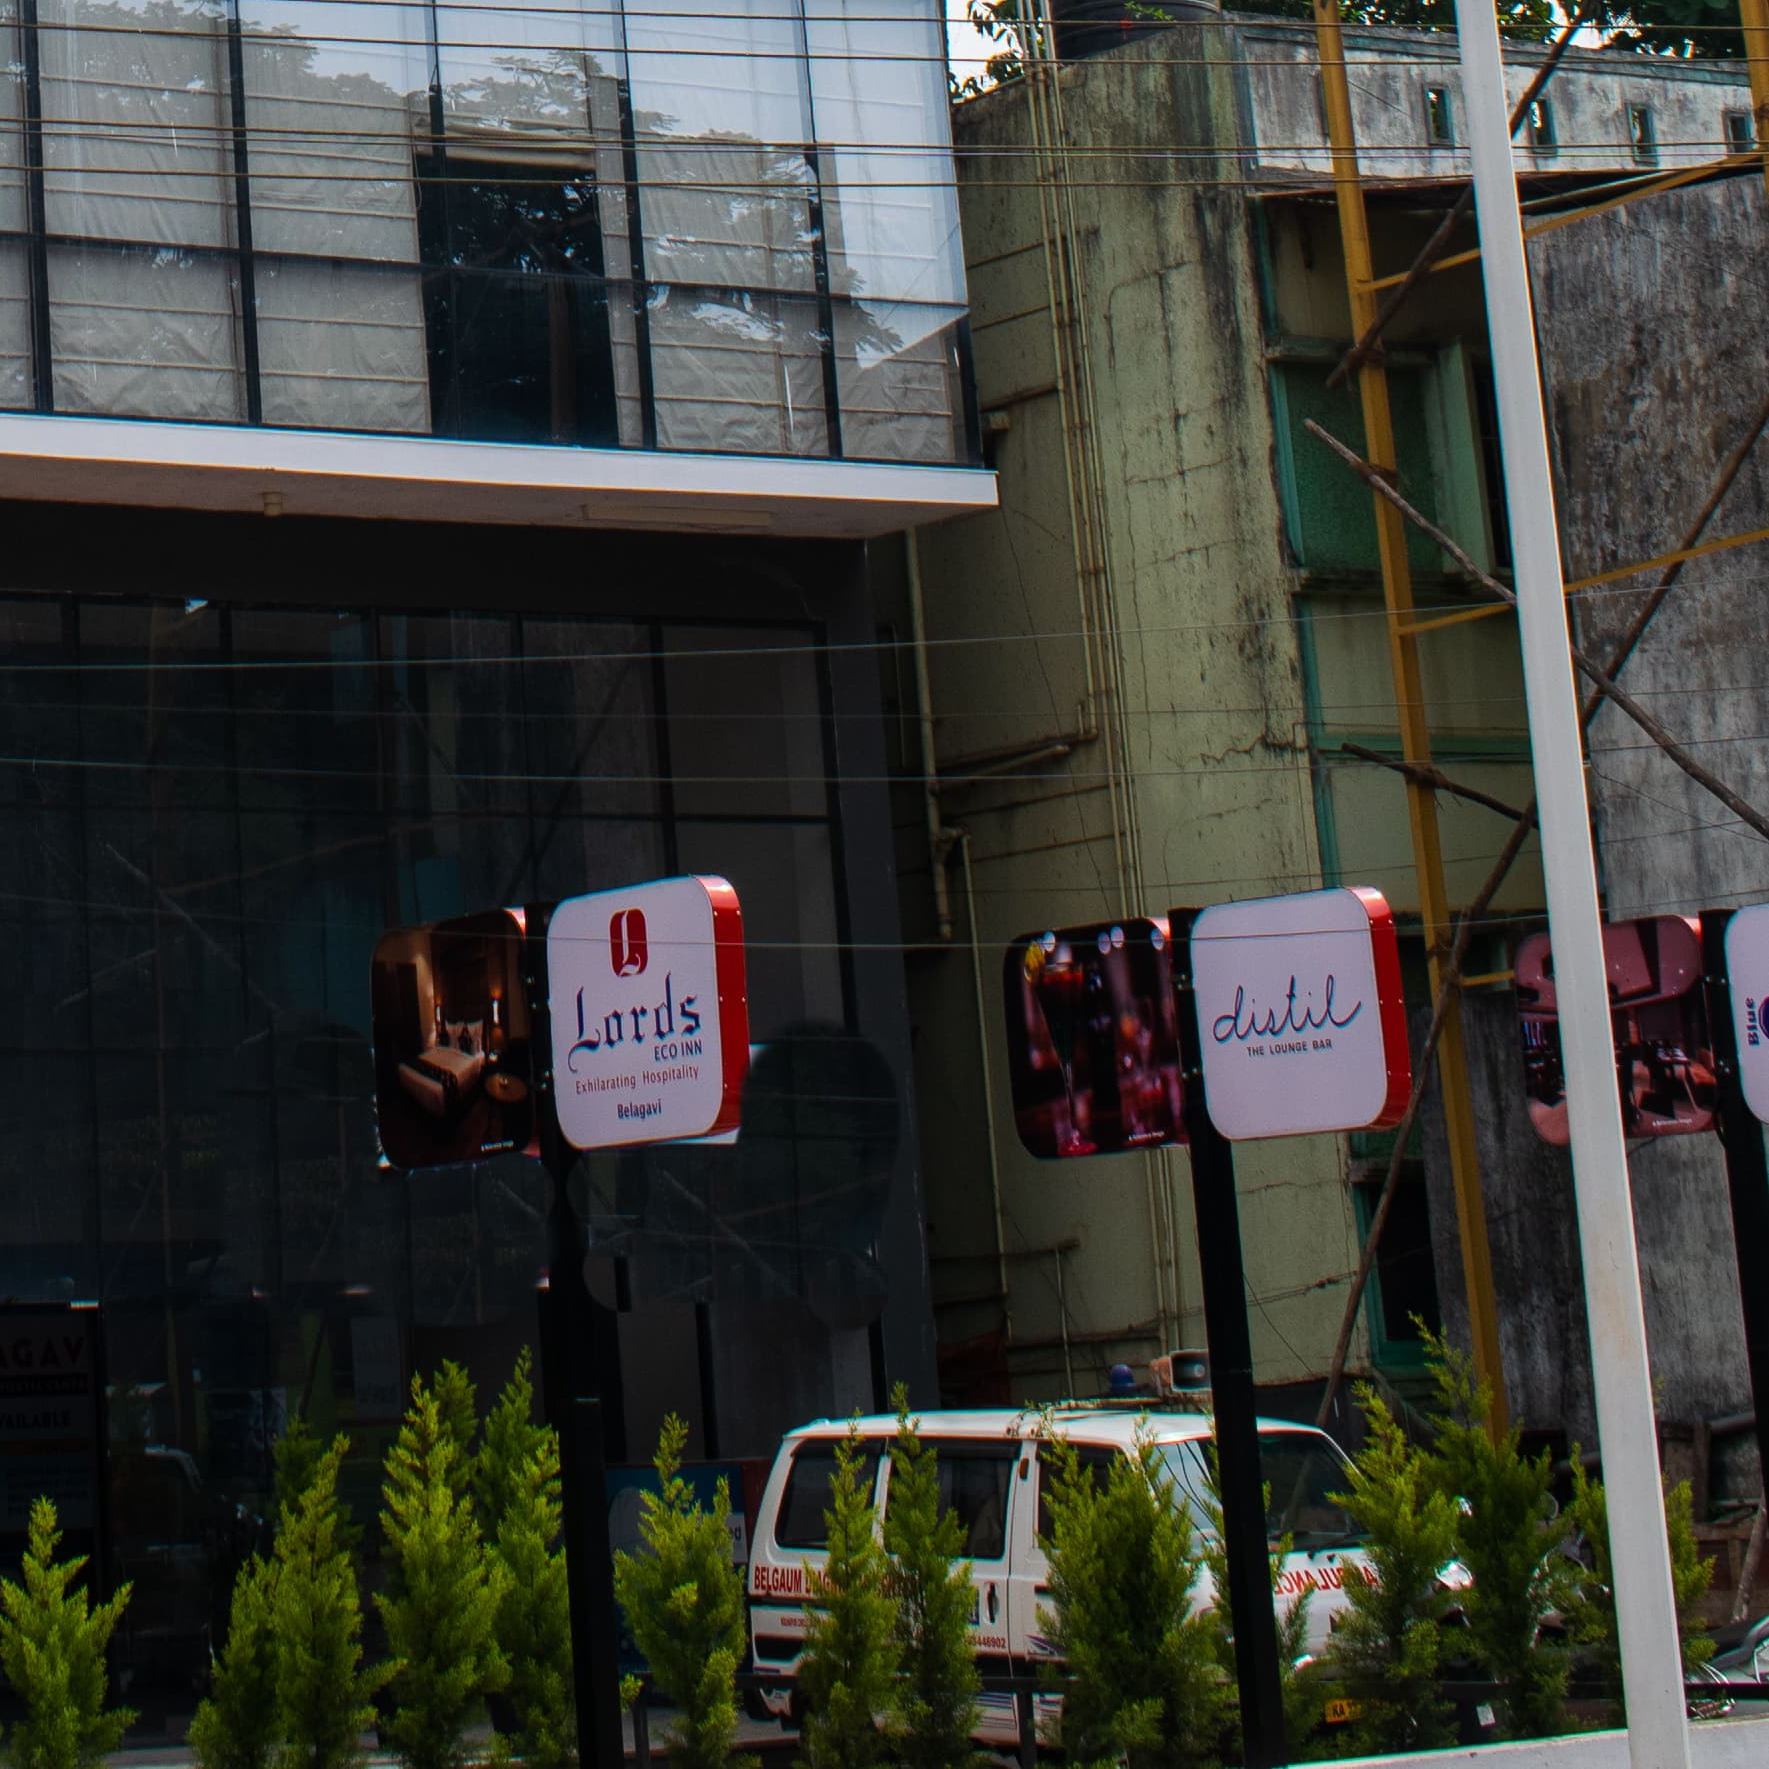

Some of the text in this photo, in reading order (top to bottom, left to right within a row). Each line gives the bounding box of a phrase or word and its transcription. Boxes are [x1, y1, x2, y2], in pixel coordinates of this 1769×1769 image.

[567, 970, 702, 1073] Lords
[1212, 974, 1362, 1044] distil
[1745, 996, 1760, 1046] Blue
[654, 1038, 703, 1062] ECO INN
[1246, 1038, 1333, 1057] THE LOUNGE BAR
[575, 1064, 700, 1095] Exhilarating Hospitality
[617, 1097, 662, 1119] Belagavi
[754, 1566, 802, 1593] BELGAUM
